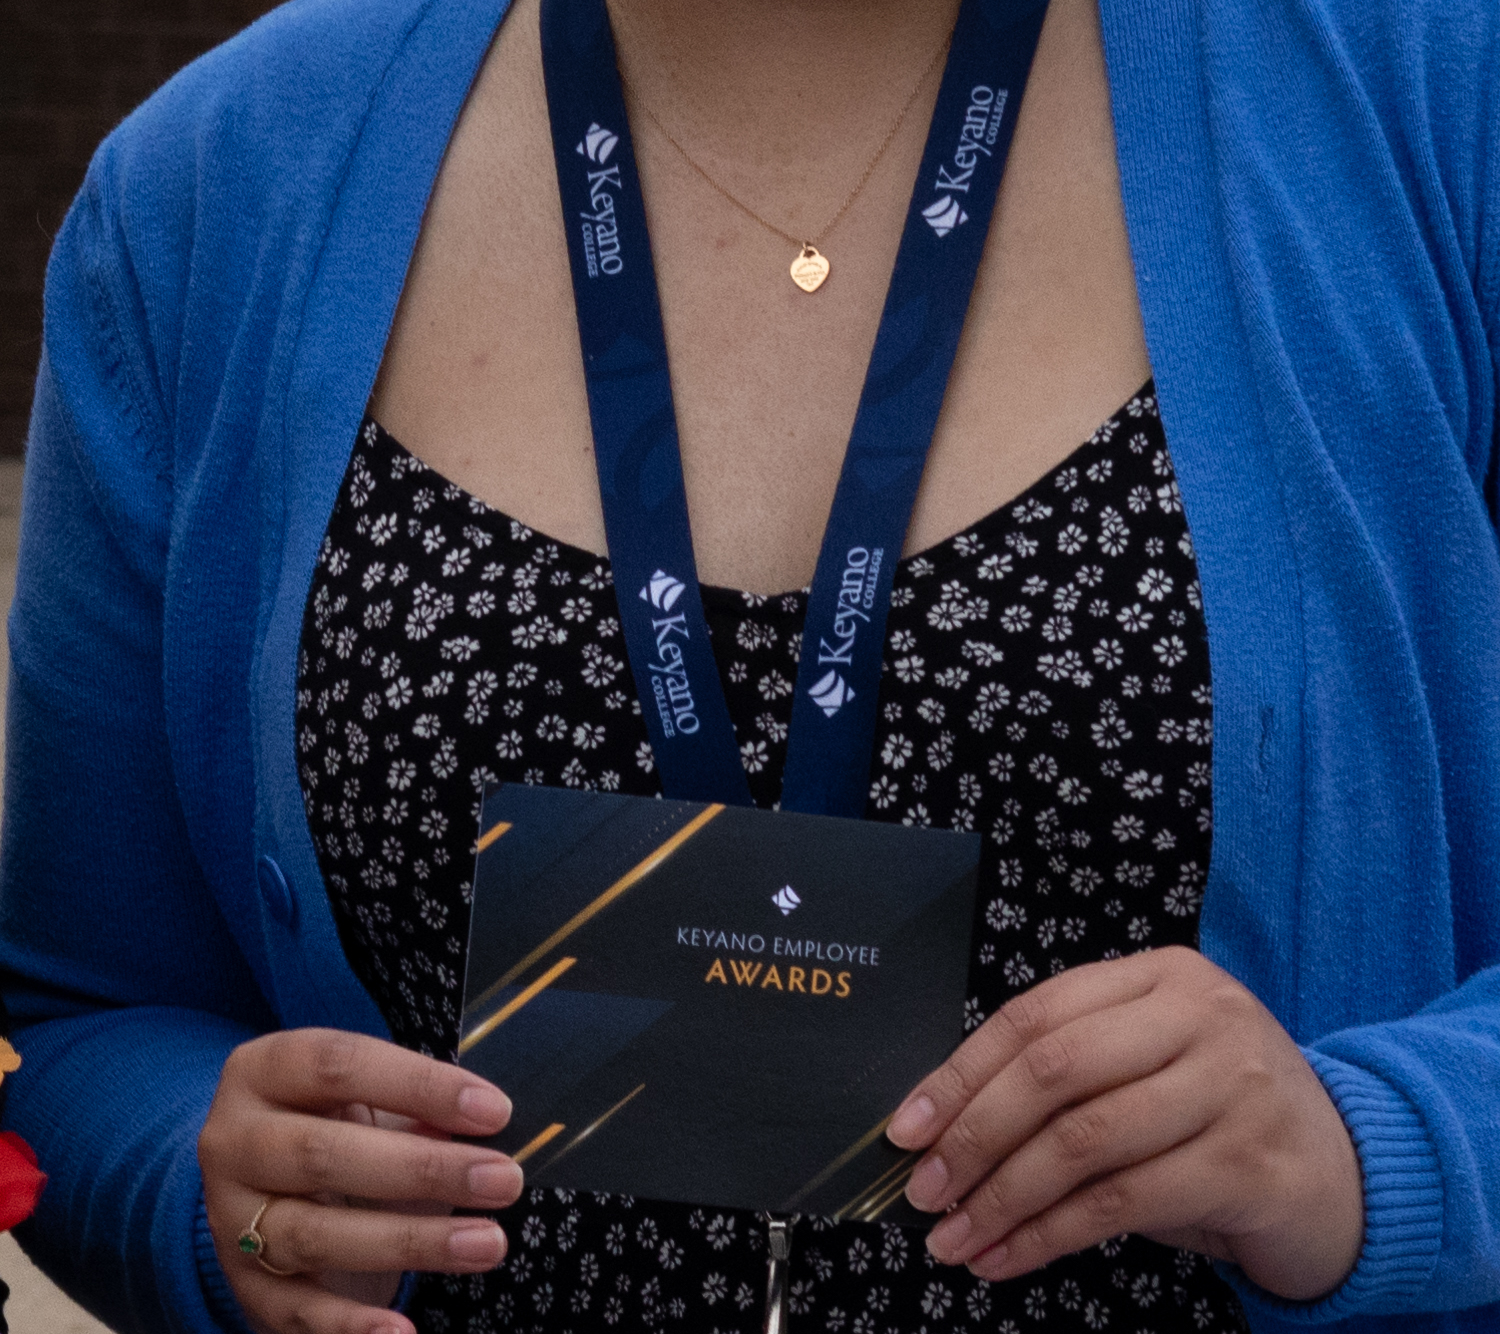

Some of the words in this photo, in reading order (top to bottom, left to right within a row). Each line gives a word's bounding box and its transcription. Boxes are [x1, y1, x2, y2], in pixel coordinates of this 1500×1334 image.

[934, 85, 994, 194] Keyano
[985, 88, 1009, 145] COLLEGE
[580, 164, 623, 275] Keyano
[582, 222, 599, 279] COLLEGE
[818, 546, 871, 666] Keyano
[863, 547, 884, 609] COLLEGE
[648, 612, 700, 735] Keyano
[650, 675, 676, 739] COLLEGE
[677, 926, 766, 954] KEYANO
[773, 936, 881, 966] EMPLOYEE
[704, 958, 853, 999] AWARDS
